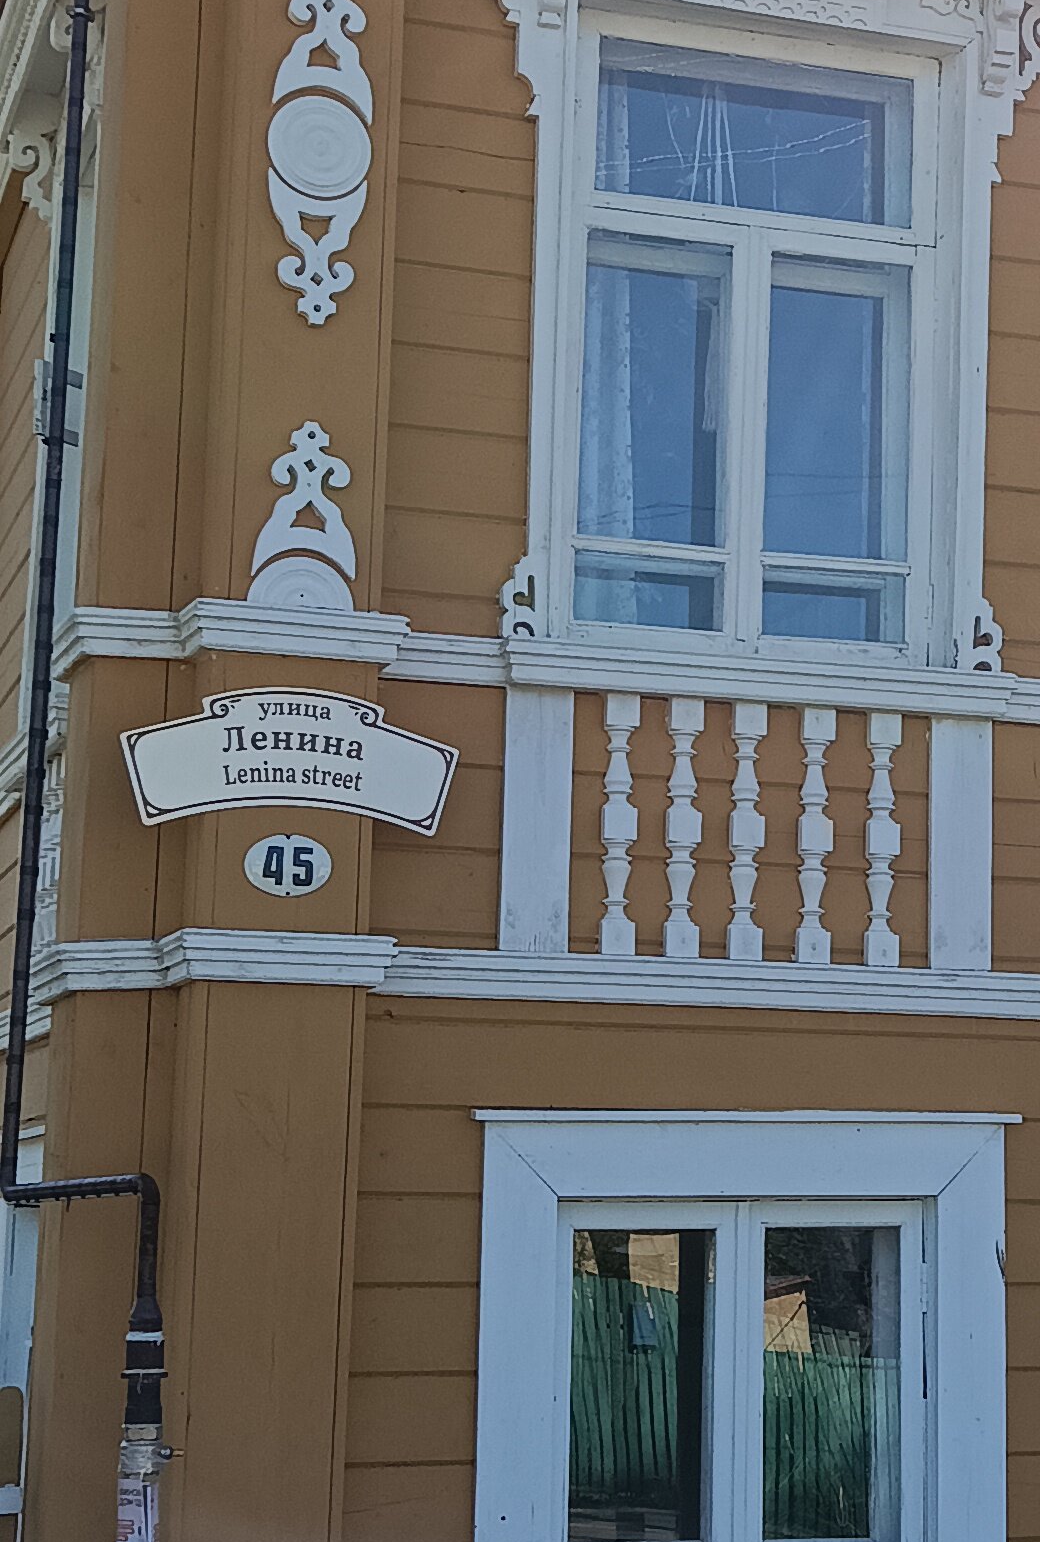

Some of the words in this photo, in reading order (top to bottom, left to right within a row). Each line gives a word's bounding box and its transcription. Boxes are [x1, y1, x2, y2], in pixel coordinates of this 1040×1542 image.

[257, 700, 332, 722] улица
[221, 725, 365, 761] Ленина
[222, 760, 298, 786] Lenina
[301, 763, 363, 792] street
[261, 845, 314, 887] 45
